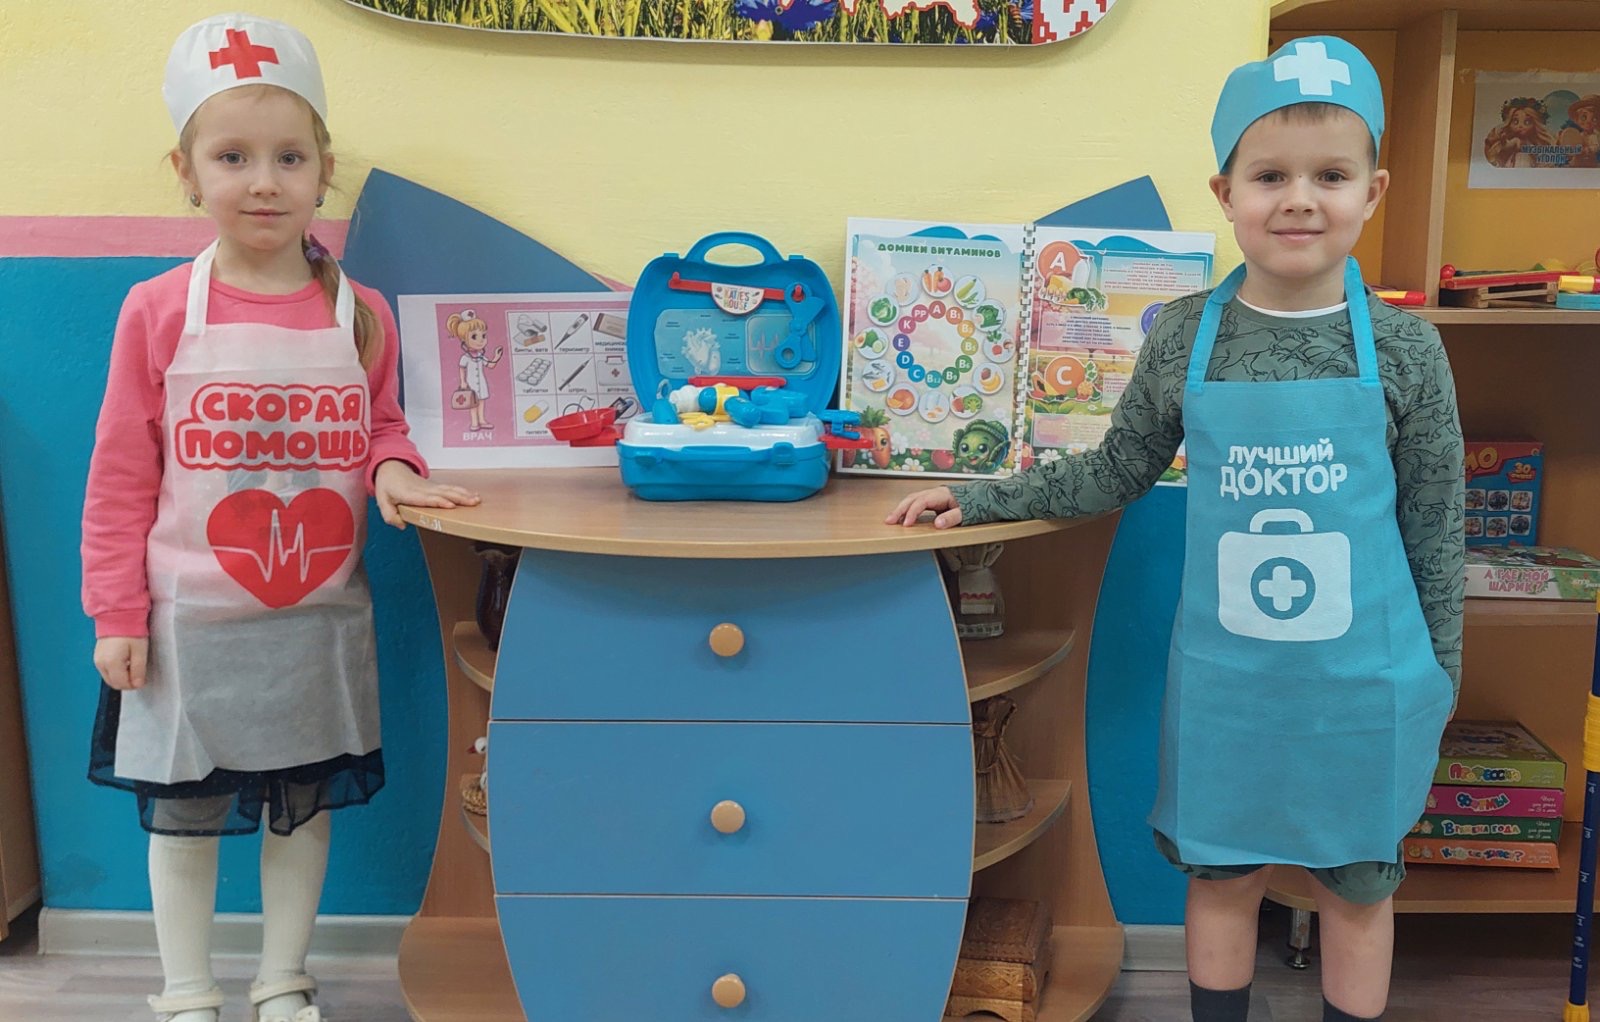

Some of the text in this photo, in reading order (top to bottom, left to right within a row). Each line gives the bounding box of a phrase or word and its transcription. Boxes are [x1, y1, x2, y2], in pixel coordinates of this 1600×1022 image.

[1521, 143, 1582, 154] МУЗЫКАЛЬНЫЙ
[878, 243, 1001, 258] ДОМИКИ ВИТАМИНОВ
[1050, 251, 1067, 272] A
[932, 304, 941, 314] A
[903, 320, 911, 329] K
[898, 338, 904, 347] E
[901, 355, 910, 365] D
[913, 369, 921, 378] C
[1056, 365, 1073, 386] C
[202, 392, 361, 423] СКОРАЯ
[463, 431, 493, 441] ВРАЧ
[184, 429, 367, 462] ПОМОЩЬ
[1514, 462, 1532, 474] 30
[1220, 463, 1348, 501] ДОКТОР
[1483, 567, 1549, 580] А ГДЕ МОЙ
